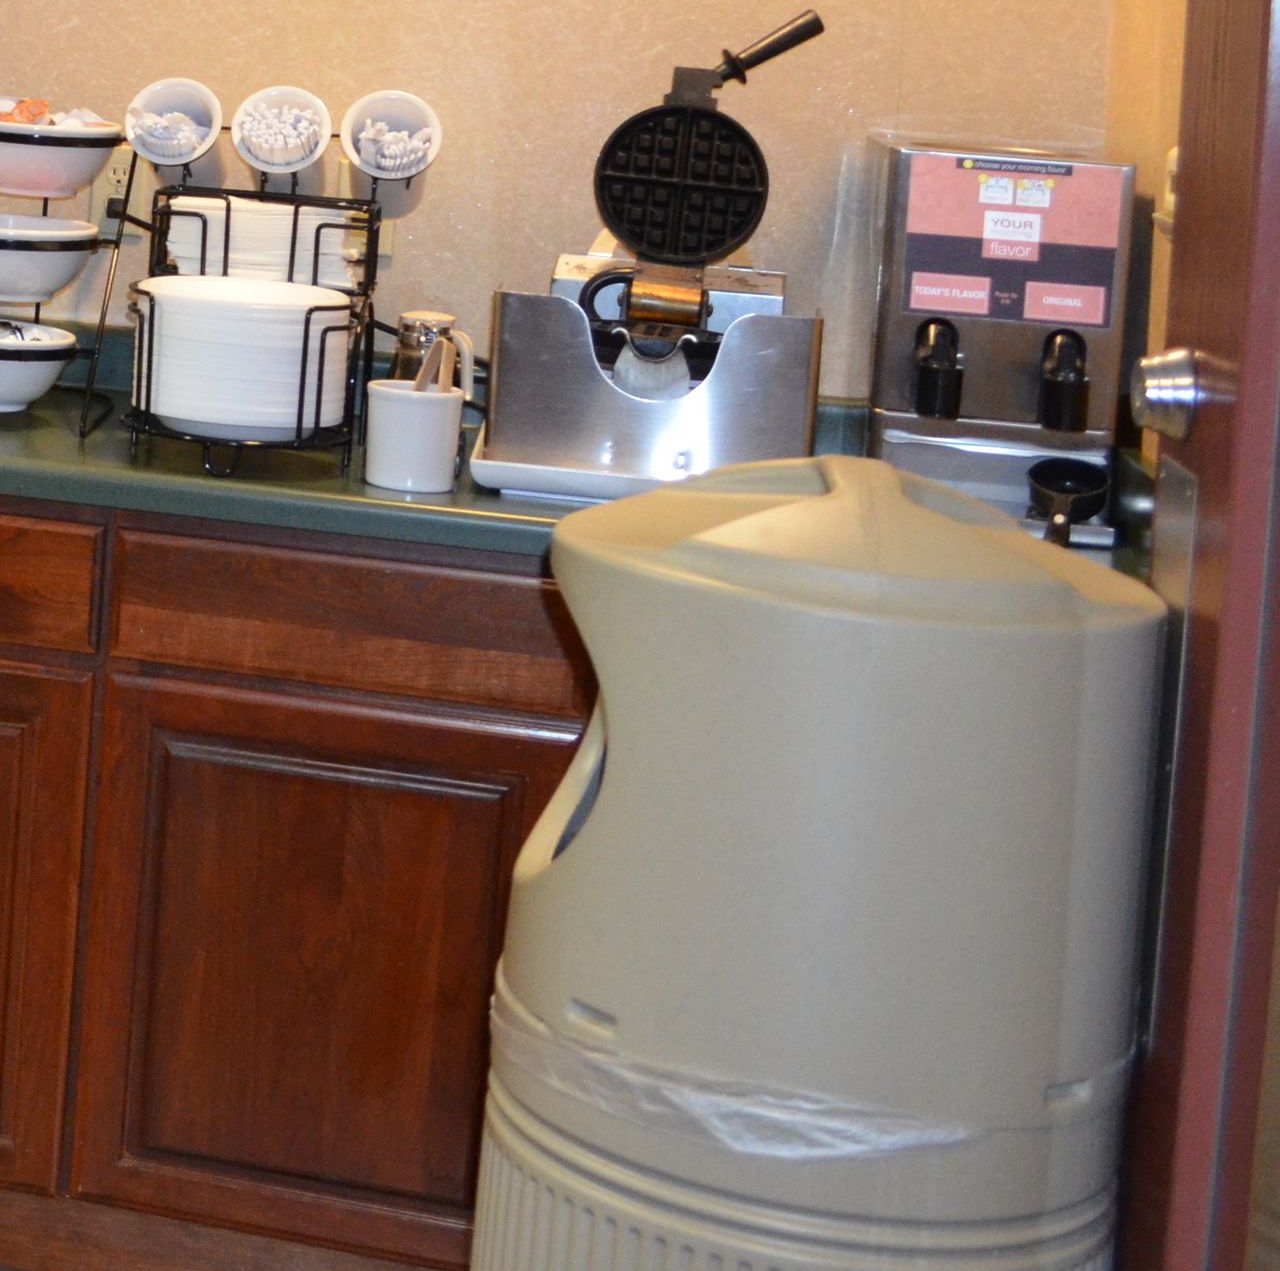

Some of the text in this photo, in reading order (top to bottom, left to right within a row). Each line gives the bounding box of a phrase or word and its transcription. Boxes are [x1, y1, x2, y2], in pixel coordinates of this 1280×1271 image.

[991, 218, 1033, 229] YOUR
[991, 241, 1032, 257] flavor
[915, 285, 951, 297] TODAY'S
[951, 288, 986, 300] FLAVOR
[1042, 296, 1084, 308] ORIGINAL
